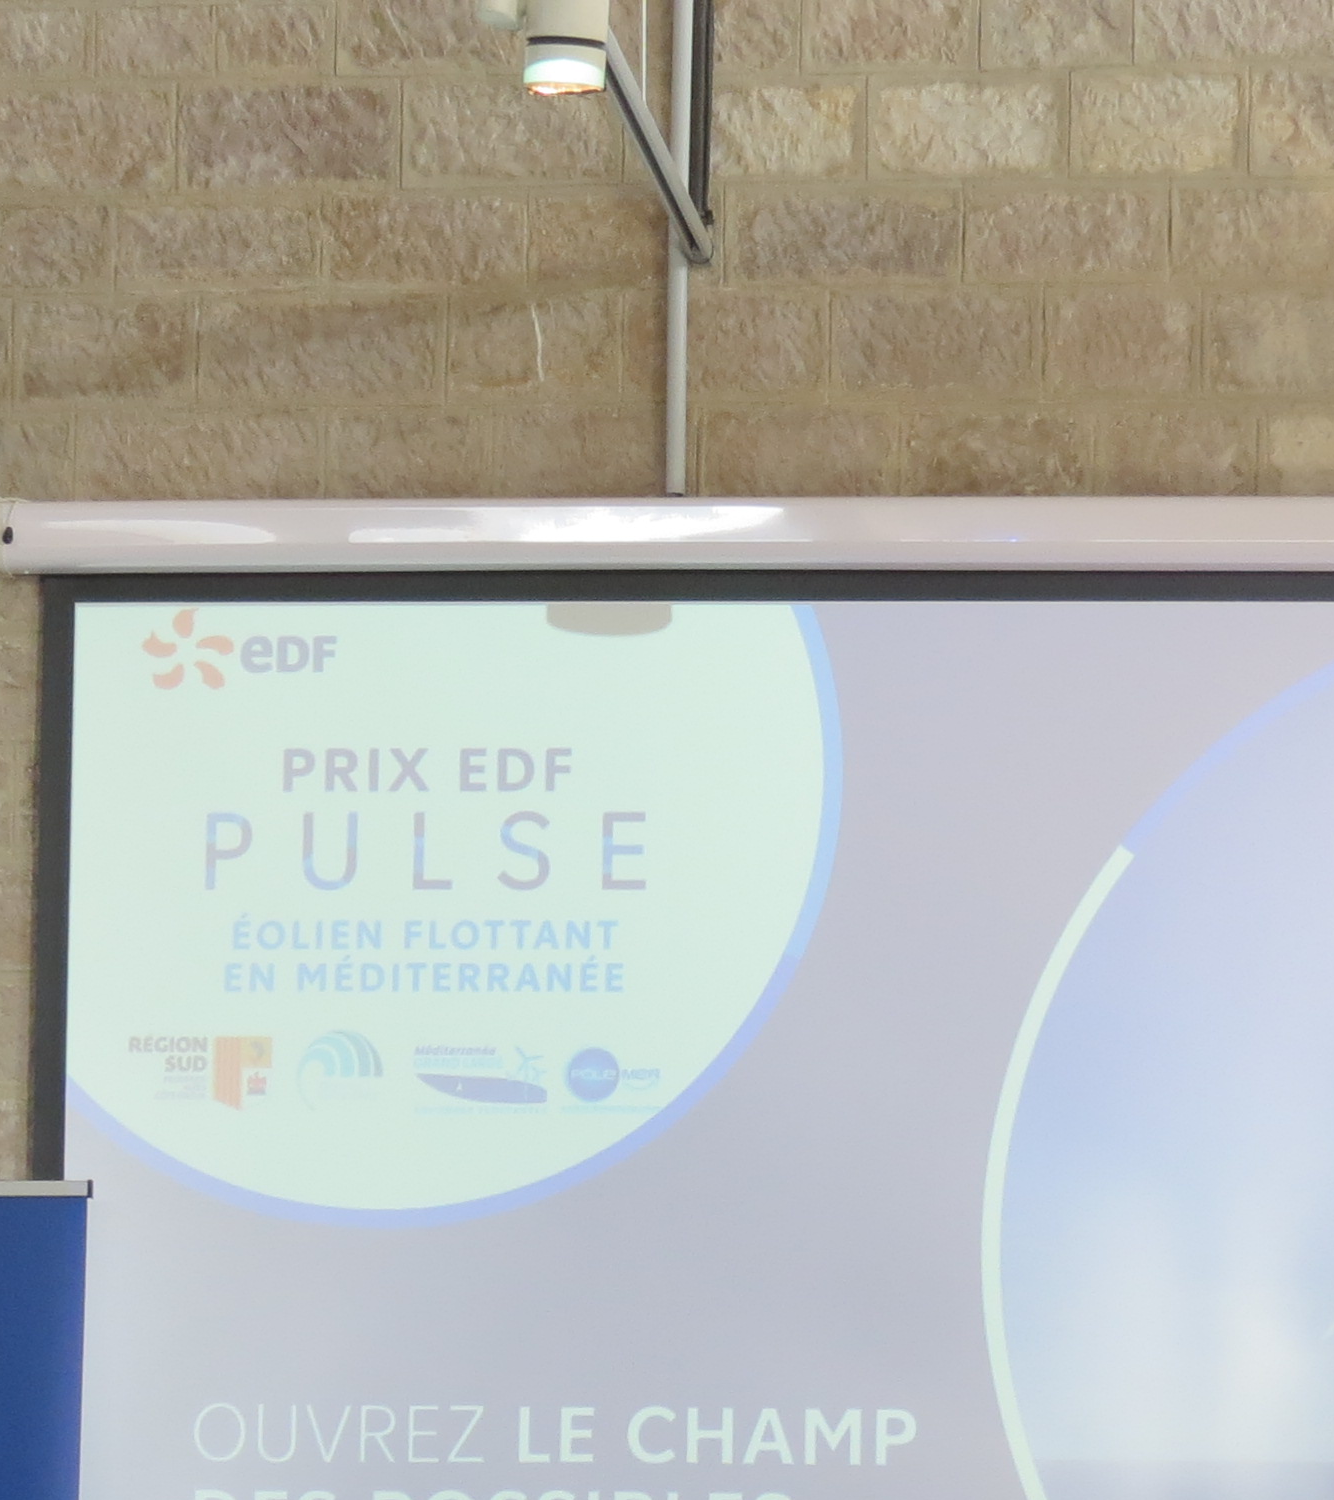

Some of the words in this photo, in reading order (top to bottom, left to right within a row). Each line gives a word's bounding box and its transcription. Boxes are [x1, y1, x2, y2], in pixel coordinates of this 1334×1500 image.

[281, 747, 430, 792] PRIX
[458, 747, 574, 792] EDF
[204, 810, 647, 892] PULSE
[231, 913, 384, 951] ÉOLIEN
[403, 919, 620, 951] FLOTTANT
[223, 961, 276, 992] EN
[296, 955, 625, 993] MÉDITERRANÉE
[164, 1055, 207, 1073] SUD
[193, 1402, 486, 1464] OUVREZ
[518, 1406, 595, 1464] LE
[627, 1406, 918, 1466] CHAMP
